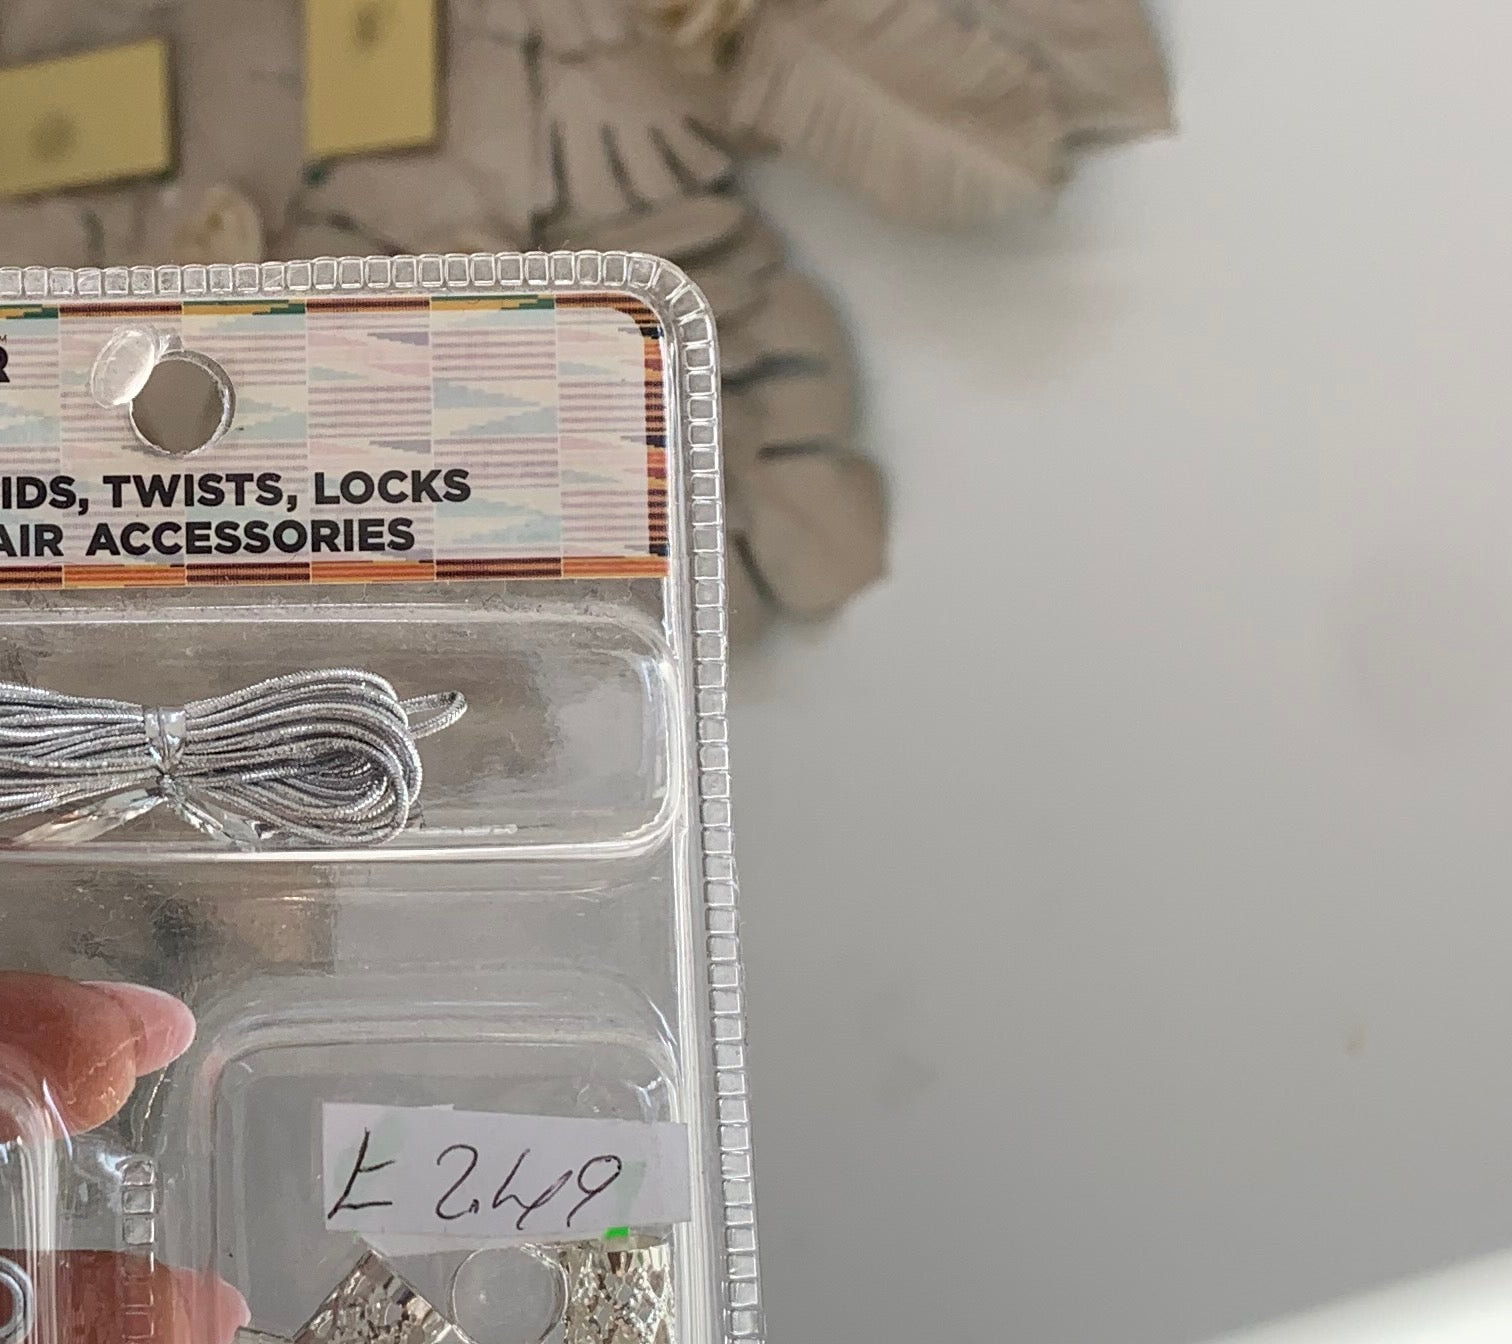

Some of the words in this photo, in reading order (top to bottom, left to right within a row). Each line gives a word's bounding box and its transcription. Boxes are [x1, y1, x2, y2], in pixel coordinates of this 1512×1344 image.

[102, 471, 298, 512] TWISTS,
[314, 468, 472, 505] LOCKS
[85, 517, 416, 556] ACCESSORIES
